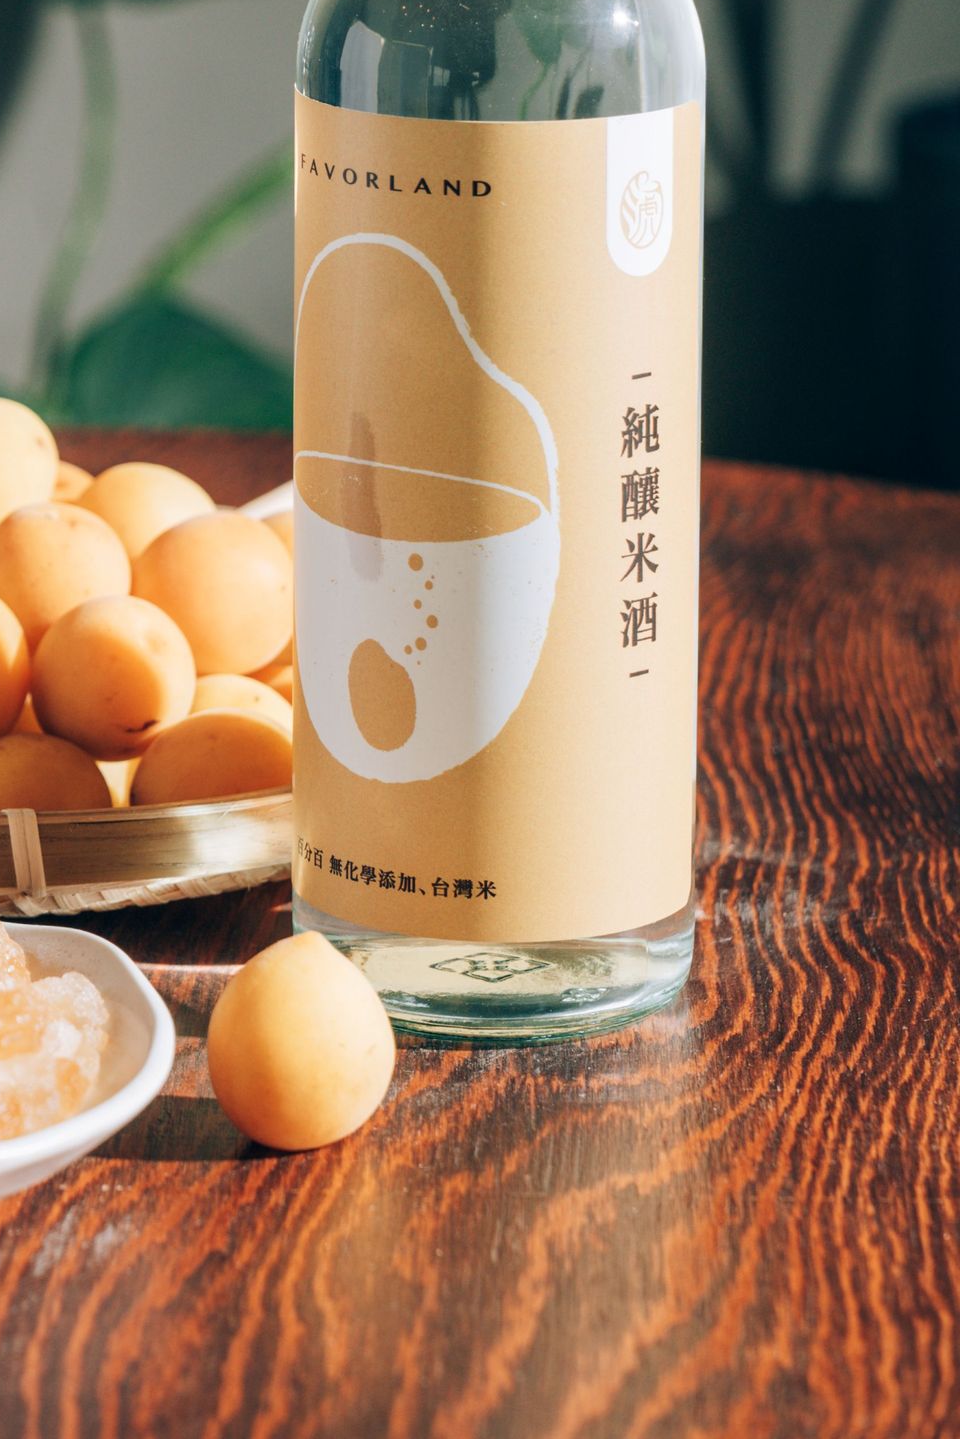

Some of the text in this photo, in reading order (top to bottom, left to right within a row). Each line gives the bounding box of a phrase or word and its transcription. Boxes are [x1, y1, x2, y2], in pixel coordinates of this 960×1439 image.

[301, 153, 492, 197] FAVORLAND
[620, 404, 660, 647] 純釀米酒
